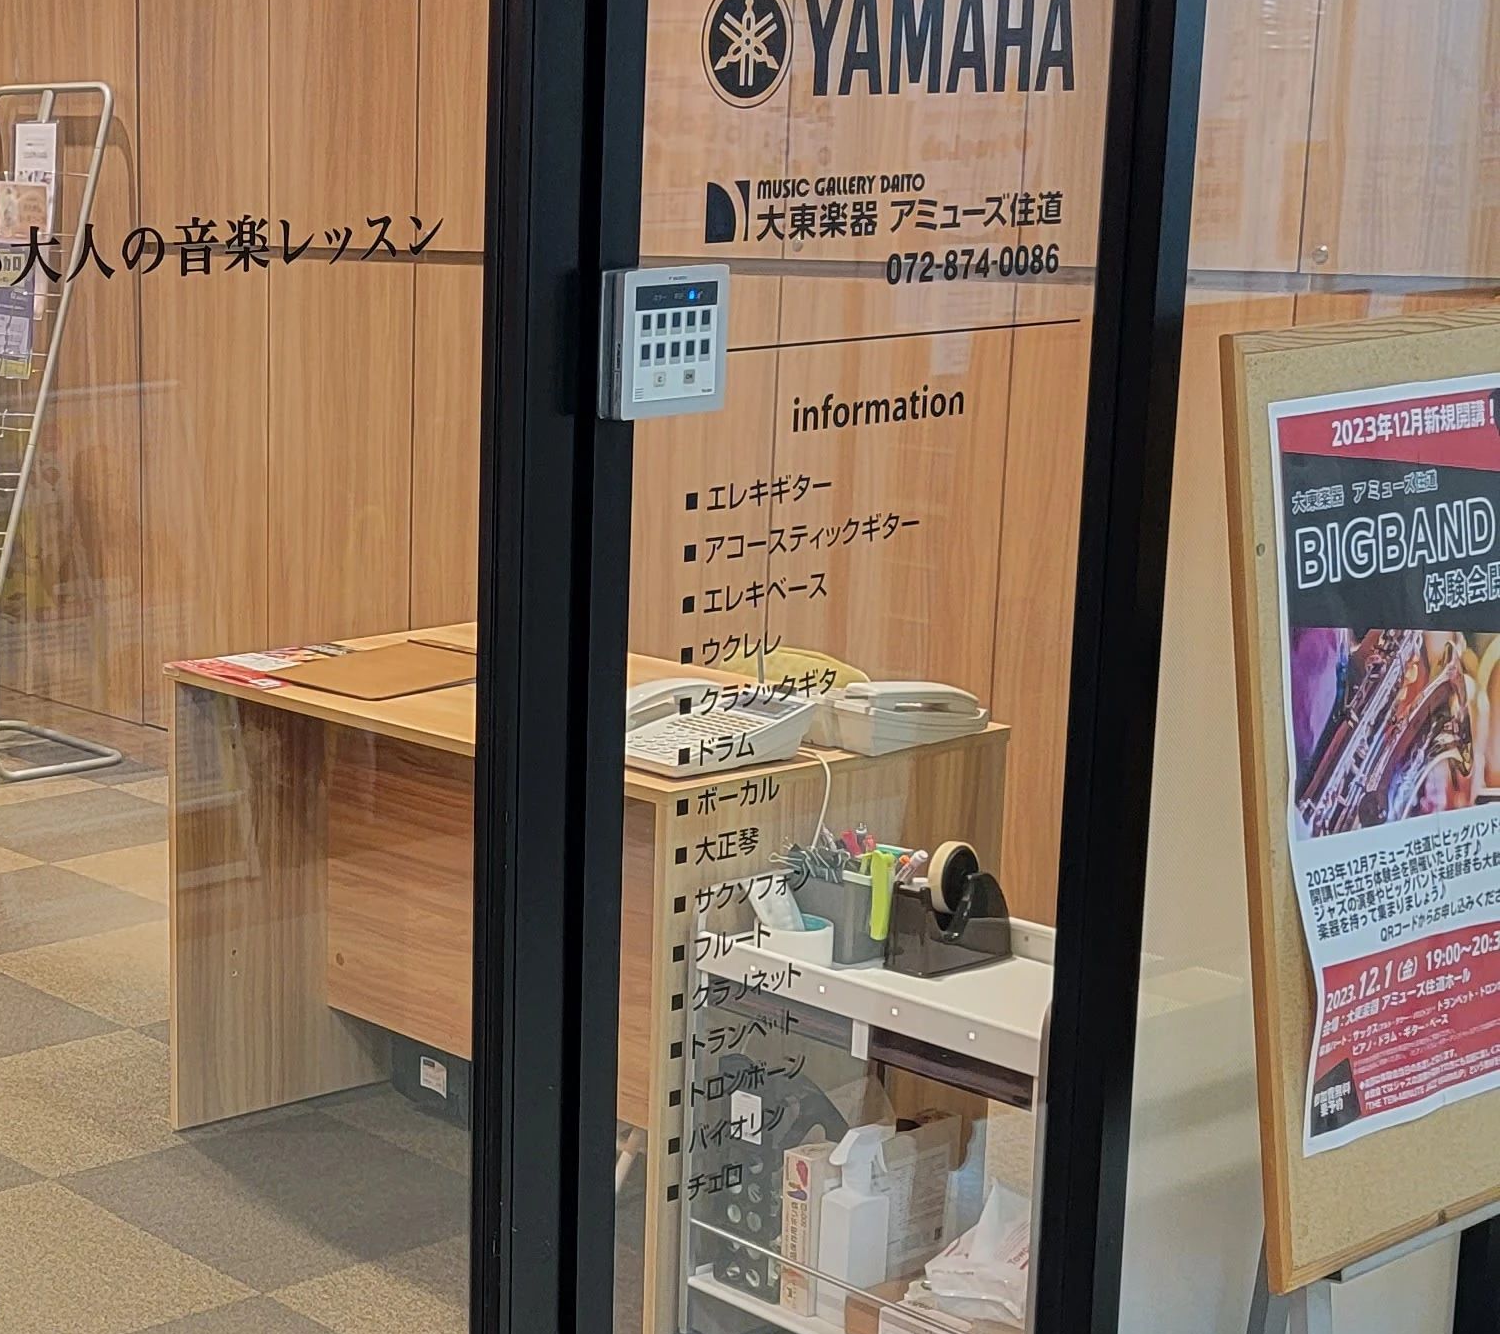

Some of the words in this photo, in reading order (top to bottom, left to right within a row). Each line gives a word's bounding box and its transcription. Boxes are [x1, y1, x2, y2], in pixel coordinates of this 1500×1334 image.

[757, 178, 810, 200] MUSIC
[814, 175, 876, 196] GALLERY
[880, 172, 926, 193] DAITO
[756, 200, 878, 242] 大東楽器
[890, 190, 1064, 233] アミューズ住道
[886, 243, 1060, 285] 072-874-0086
[792, 384, 965, 433] information
[707, 474, 832, 512] エレキギター
[705, 513, 920, 564] アコースティックギター
[1295, 497, 1496, 589] BIGBAND
[703, 572, 828, 614] エレキベース
[701, 631, 782, 666] ウクレレ
[700, 732, 754, 766] ドラム
[698, 776, 780, 815] ボーカル
[695, 827, 759, 865] 大正琴
[695, 869, 810, 913] サクソフォン
[694, 922, 771, 962] フルート
[691, 1056, 805, 1107] トロンボーン
[689, 1107, 784, 1153] バイオリン
[688, 1164, 742, 1200] チェロ
